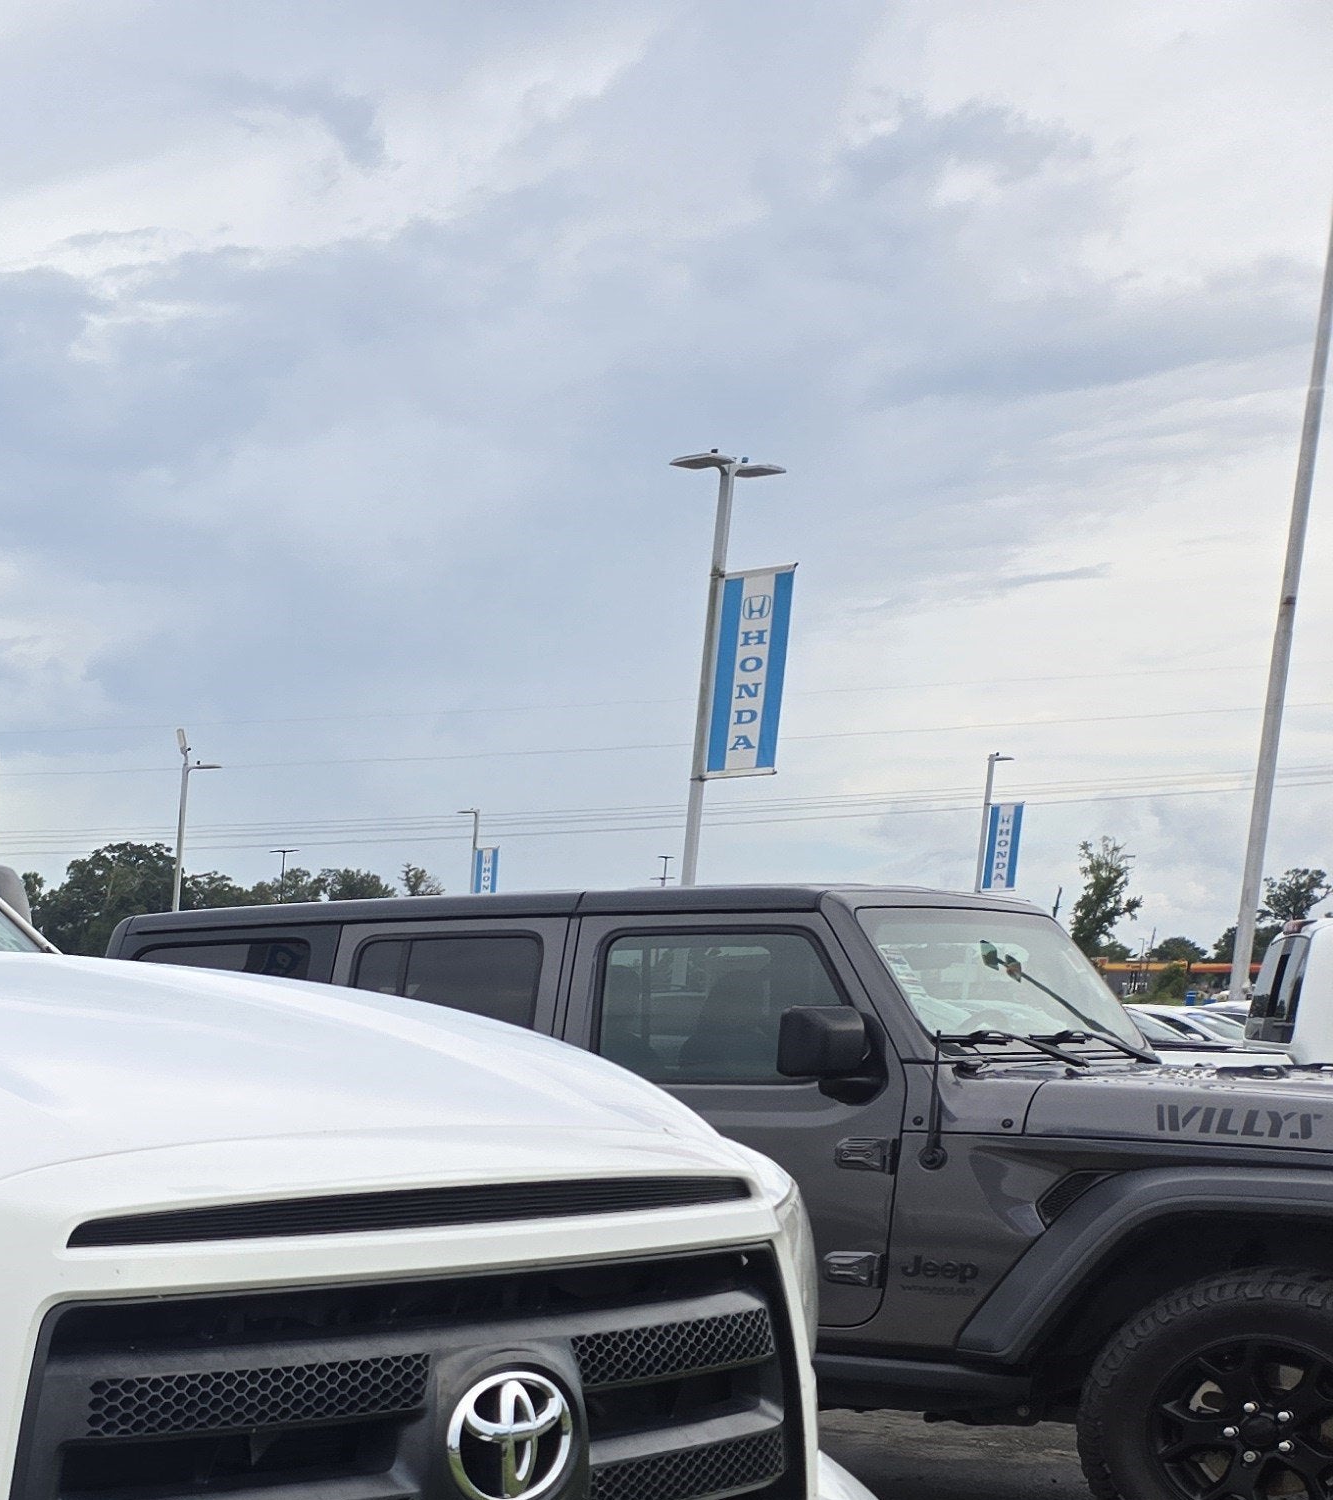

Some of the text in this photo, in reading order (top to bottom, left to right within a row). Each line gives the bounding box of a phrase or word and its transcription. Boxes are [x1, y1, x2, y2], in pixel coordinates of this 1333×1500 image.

[729, 628, 768, 751] HONDA
[993, 828, 1010, 881] HONDA
[1156, 1103, 1324, 1141] WILLYS
[901, 1254, 979, 1284] Jeep
